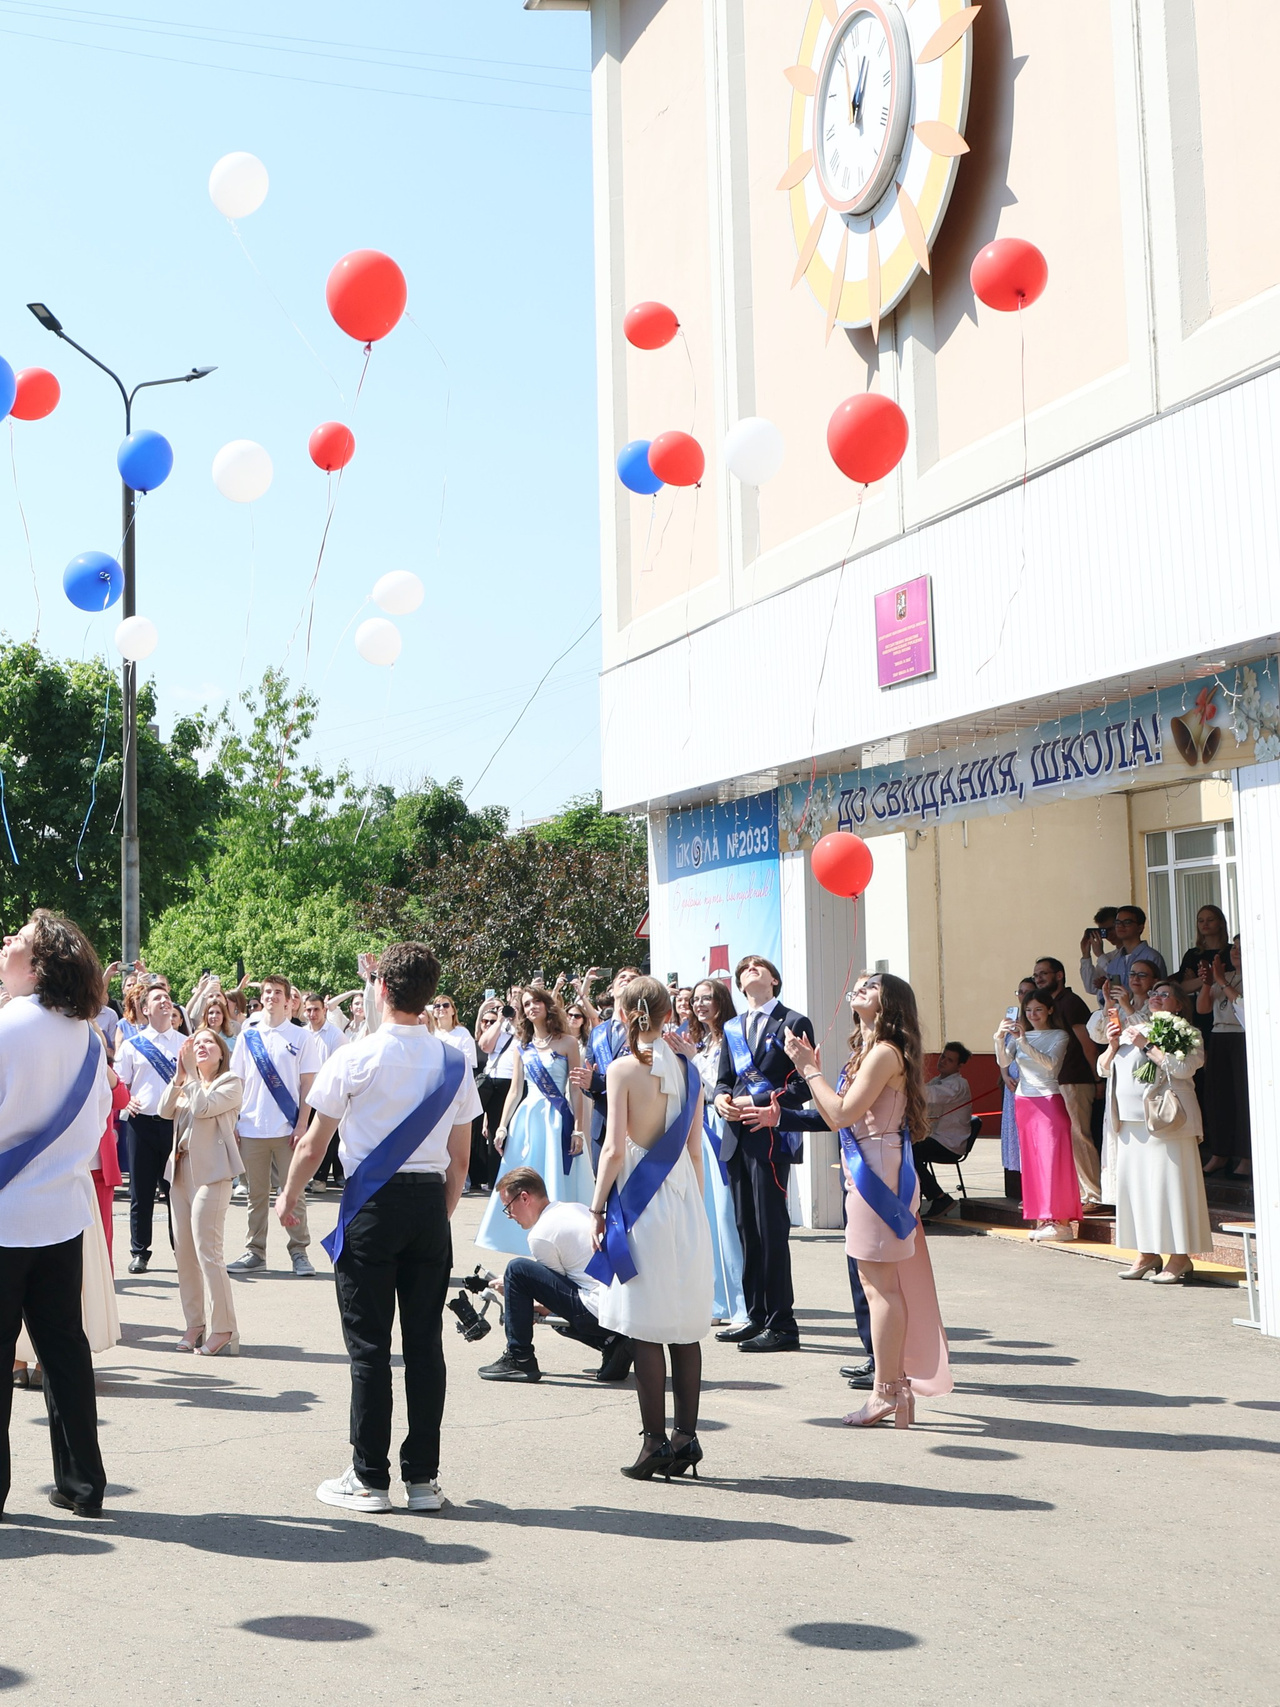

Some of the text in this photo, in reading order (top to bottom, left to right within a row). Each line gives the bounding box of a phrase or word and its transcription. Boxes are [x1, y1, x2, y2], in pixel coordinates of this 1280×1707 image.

[837, 713, 1163, 832] ДО СВИДАНИЯ, ШКОЛА!
[675, 835, 720, 869] ШКОЛА
